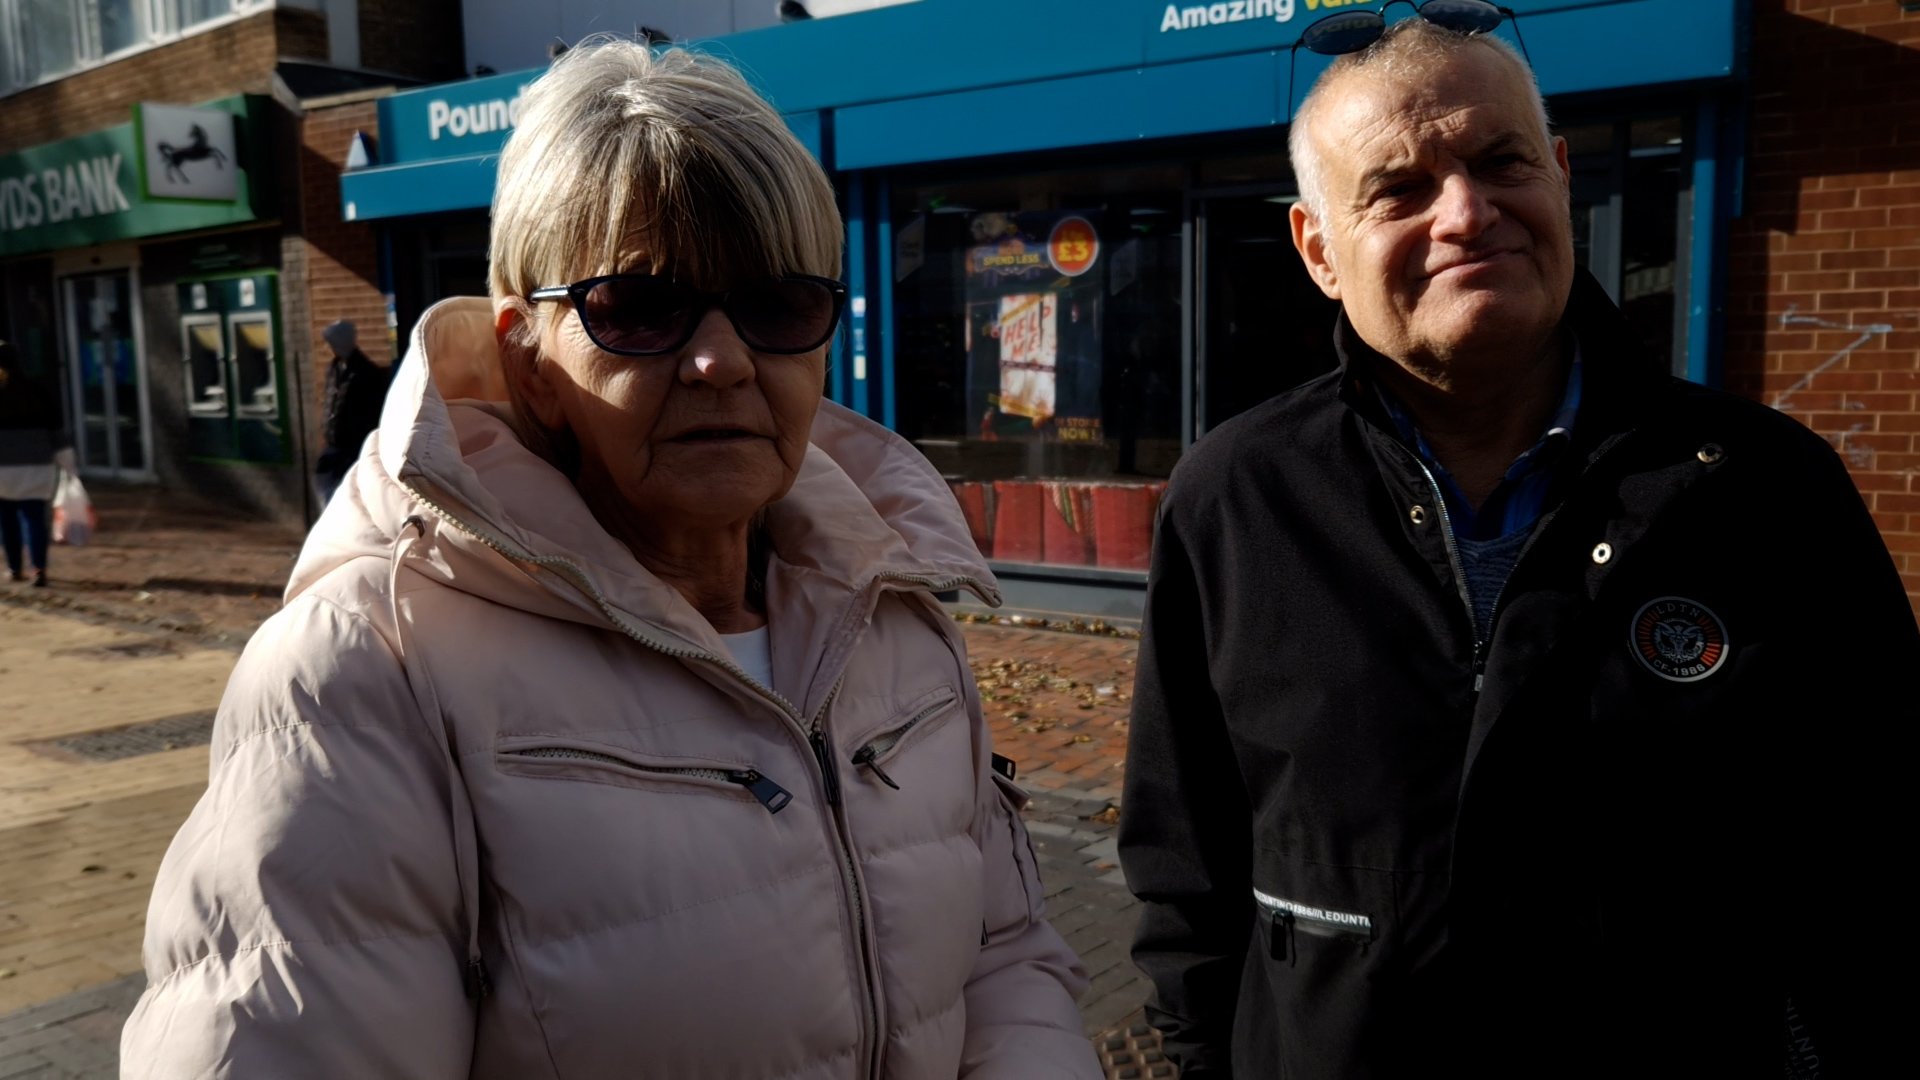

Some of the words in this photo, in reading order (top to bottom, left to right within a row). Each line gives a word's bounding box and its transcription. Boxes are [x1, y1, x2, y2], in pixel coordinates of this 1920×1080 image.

[1160, 0, 1295, 33] Amazing
[43, 153, 130, 223] BANK
[983, 255, 1014, 266] SPEND
[1016, 253, 1040, 265] LESS
[1058, 240, 1089, 262] £3
[1058, 427, 1096, 440] NOW!
